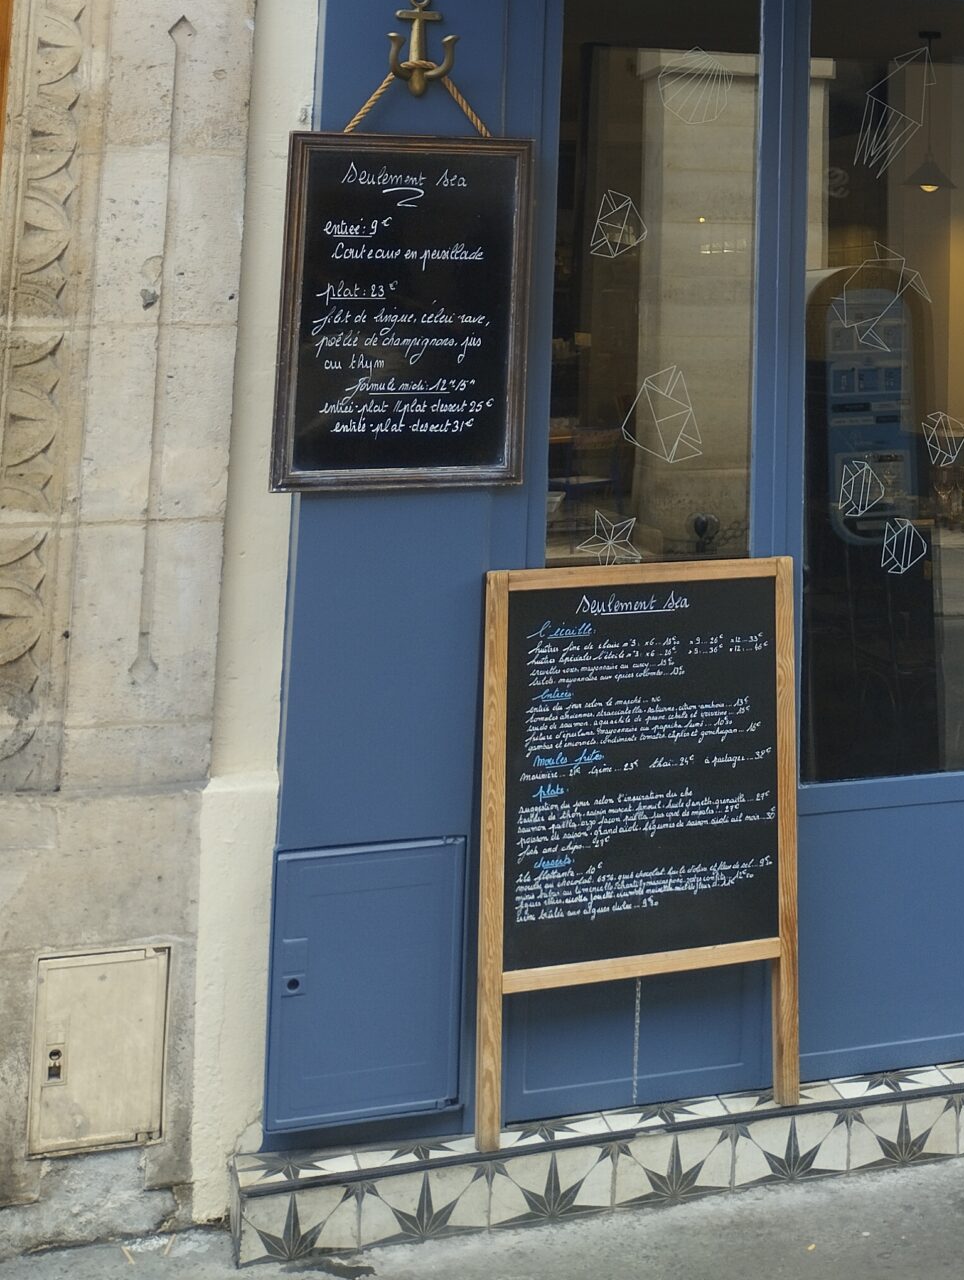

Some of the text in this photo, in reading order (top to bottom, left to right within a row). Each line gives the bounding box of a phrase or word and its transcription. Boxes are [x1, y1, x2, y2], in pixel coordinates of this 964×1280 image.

[341, 162, 467, 187] Seulement Sea
[404, 248, 417, 260] en
[420, 243, 485, 271] persillade
[312, 306, 351, 336] filet
[354, 310, 366, 323] de
[364, 334, 378, 347] de
[457, 332, 482, 364] jus
[324, 354, 385, 378] au thym
[576, 590, 690, 614] Seulement Sea
[553, 703, 563, 711] du
[561, 801, 570, 809] du
[542, 844, 558, 853] and
